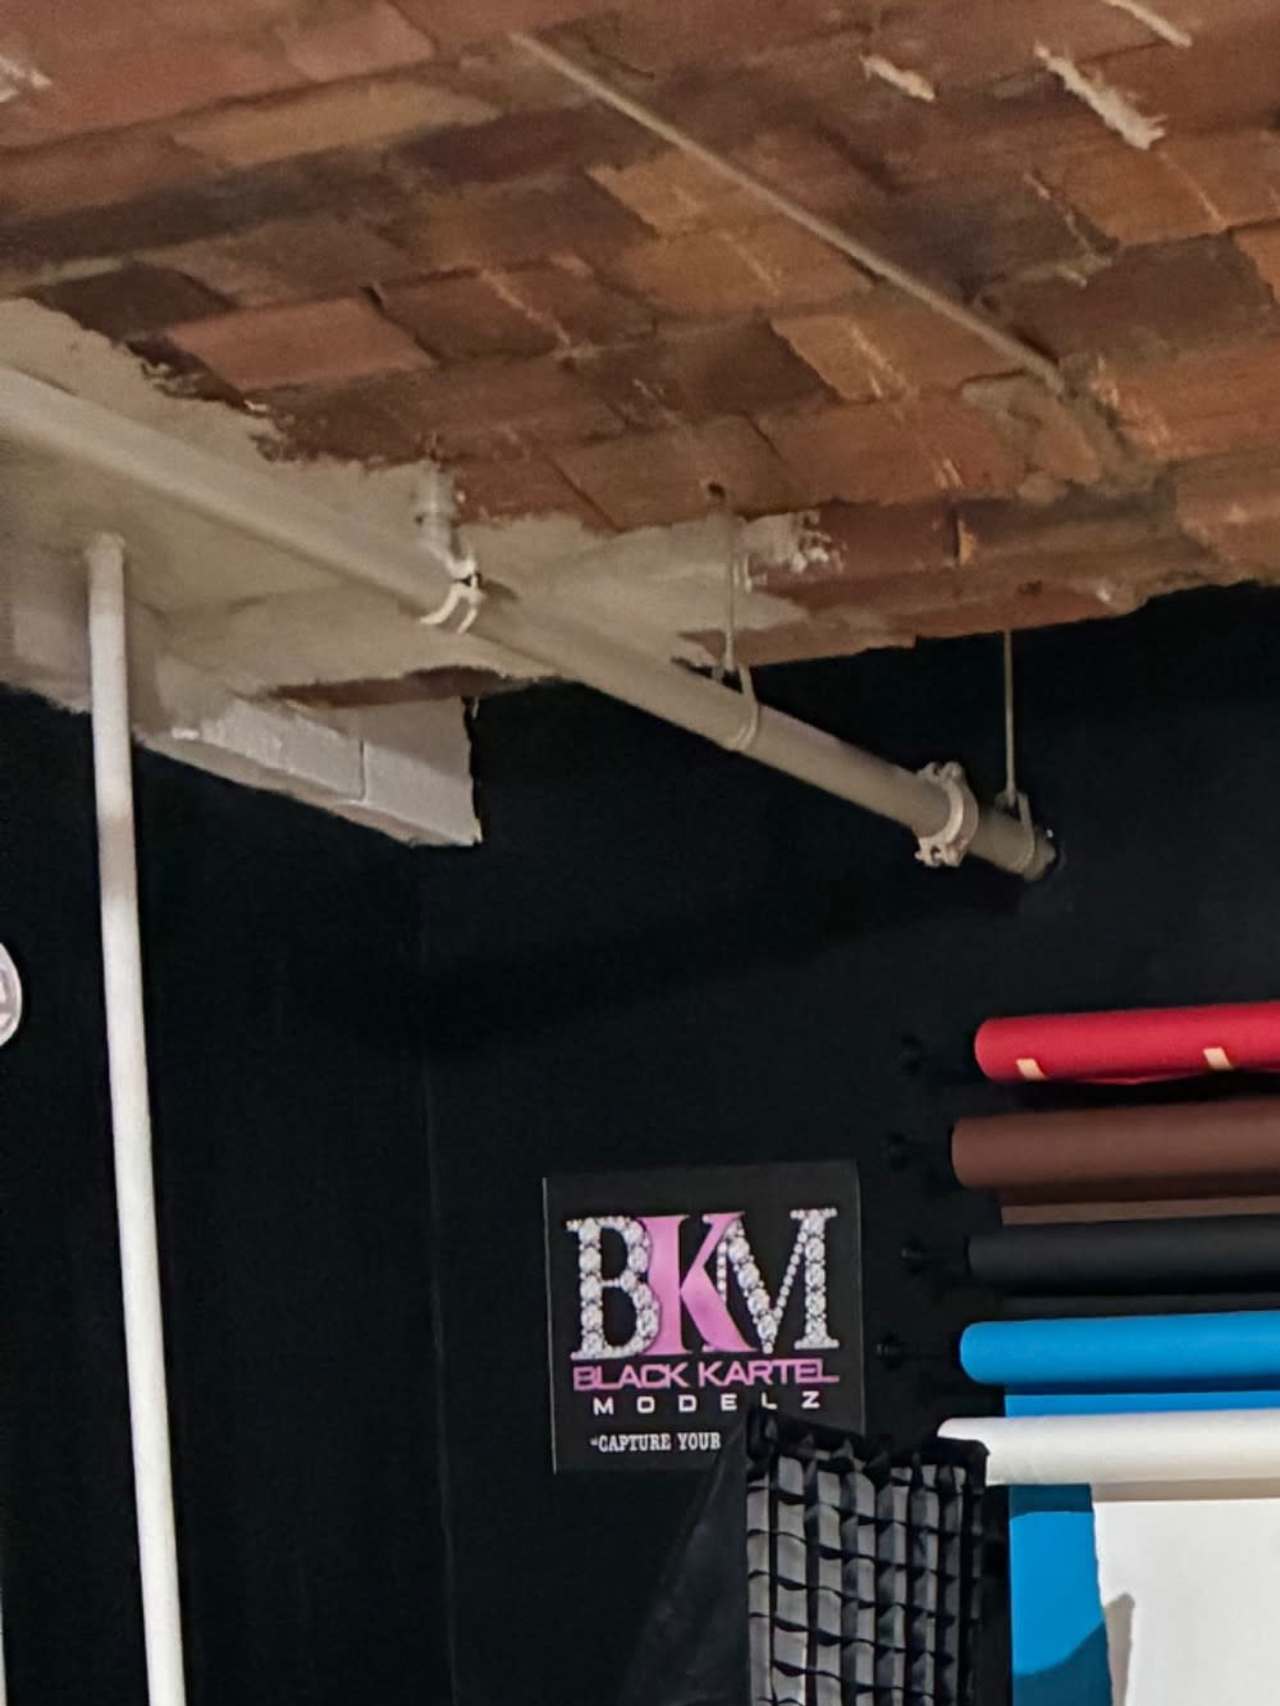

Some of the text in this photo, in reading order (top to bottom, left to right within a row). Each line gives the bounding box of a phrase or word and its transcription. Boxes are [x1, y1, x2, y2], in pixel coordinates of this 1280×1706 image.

[565, 1208, 839, 1361] BKM
[573, 1358, 840, 1391] BLACK KARTEL
[593, 1390, 821, 1415] MODELZ
[677, 1431, 722, 1451] YOUR
